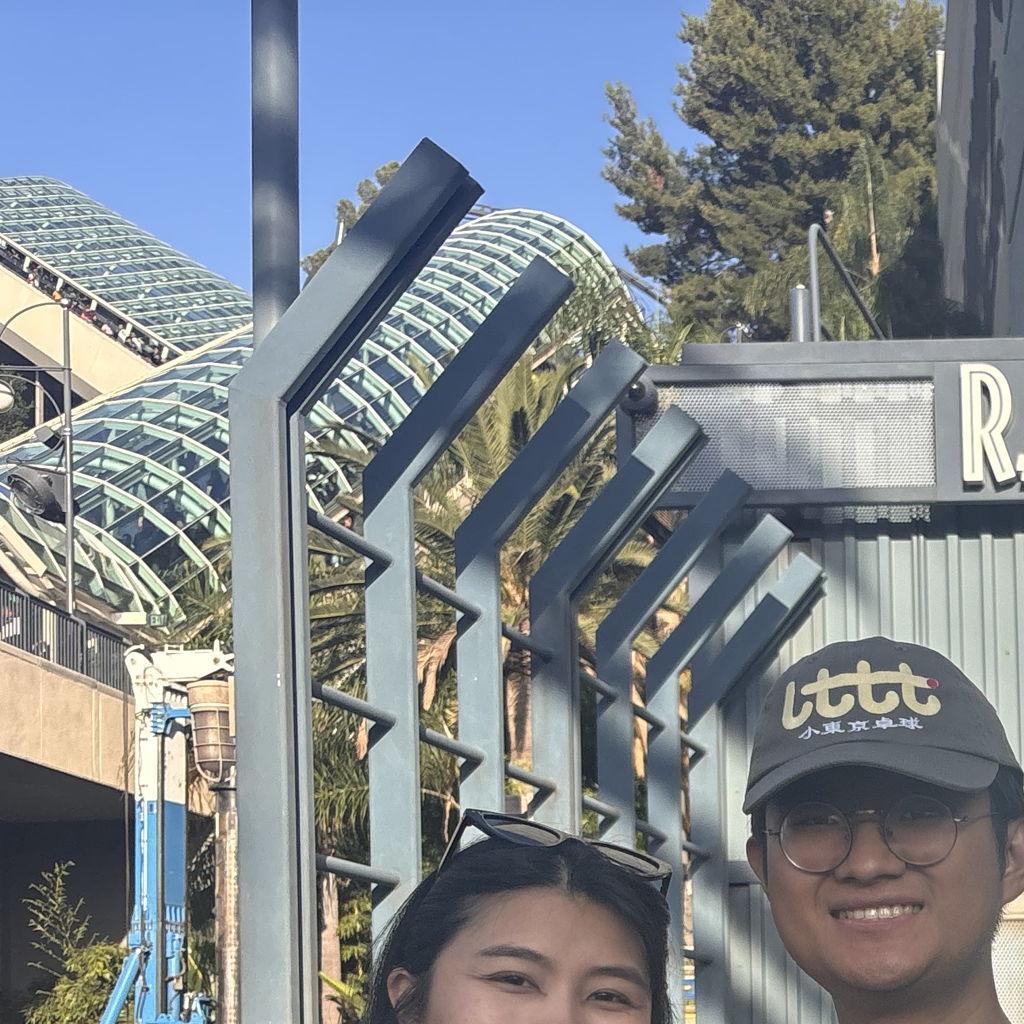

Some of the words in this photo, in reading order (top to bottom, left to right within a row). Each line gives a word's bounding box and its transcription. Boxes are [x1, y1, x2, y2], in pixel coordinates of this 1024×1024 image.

[798, 716, 924, 740] 小東京卓球
